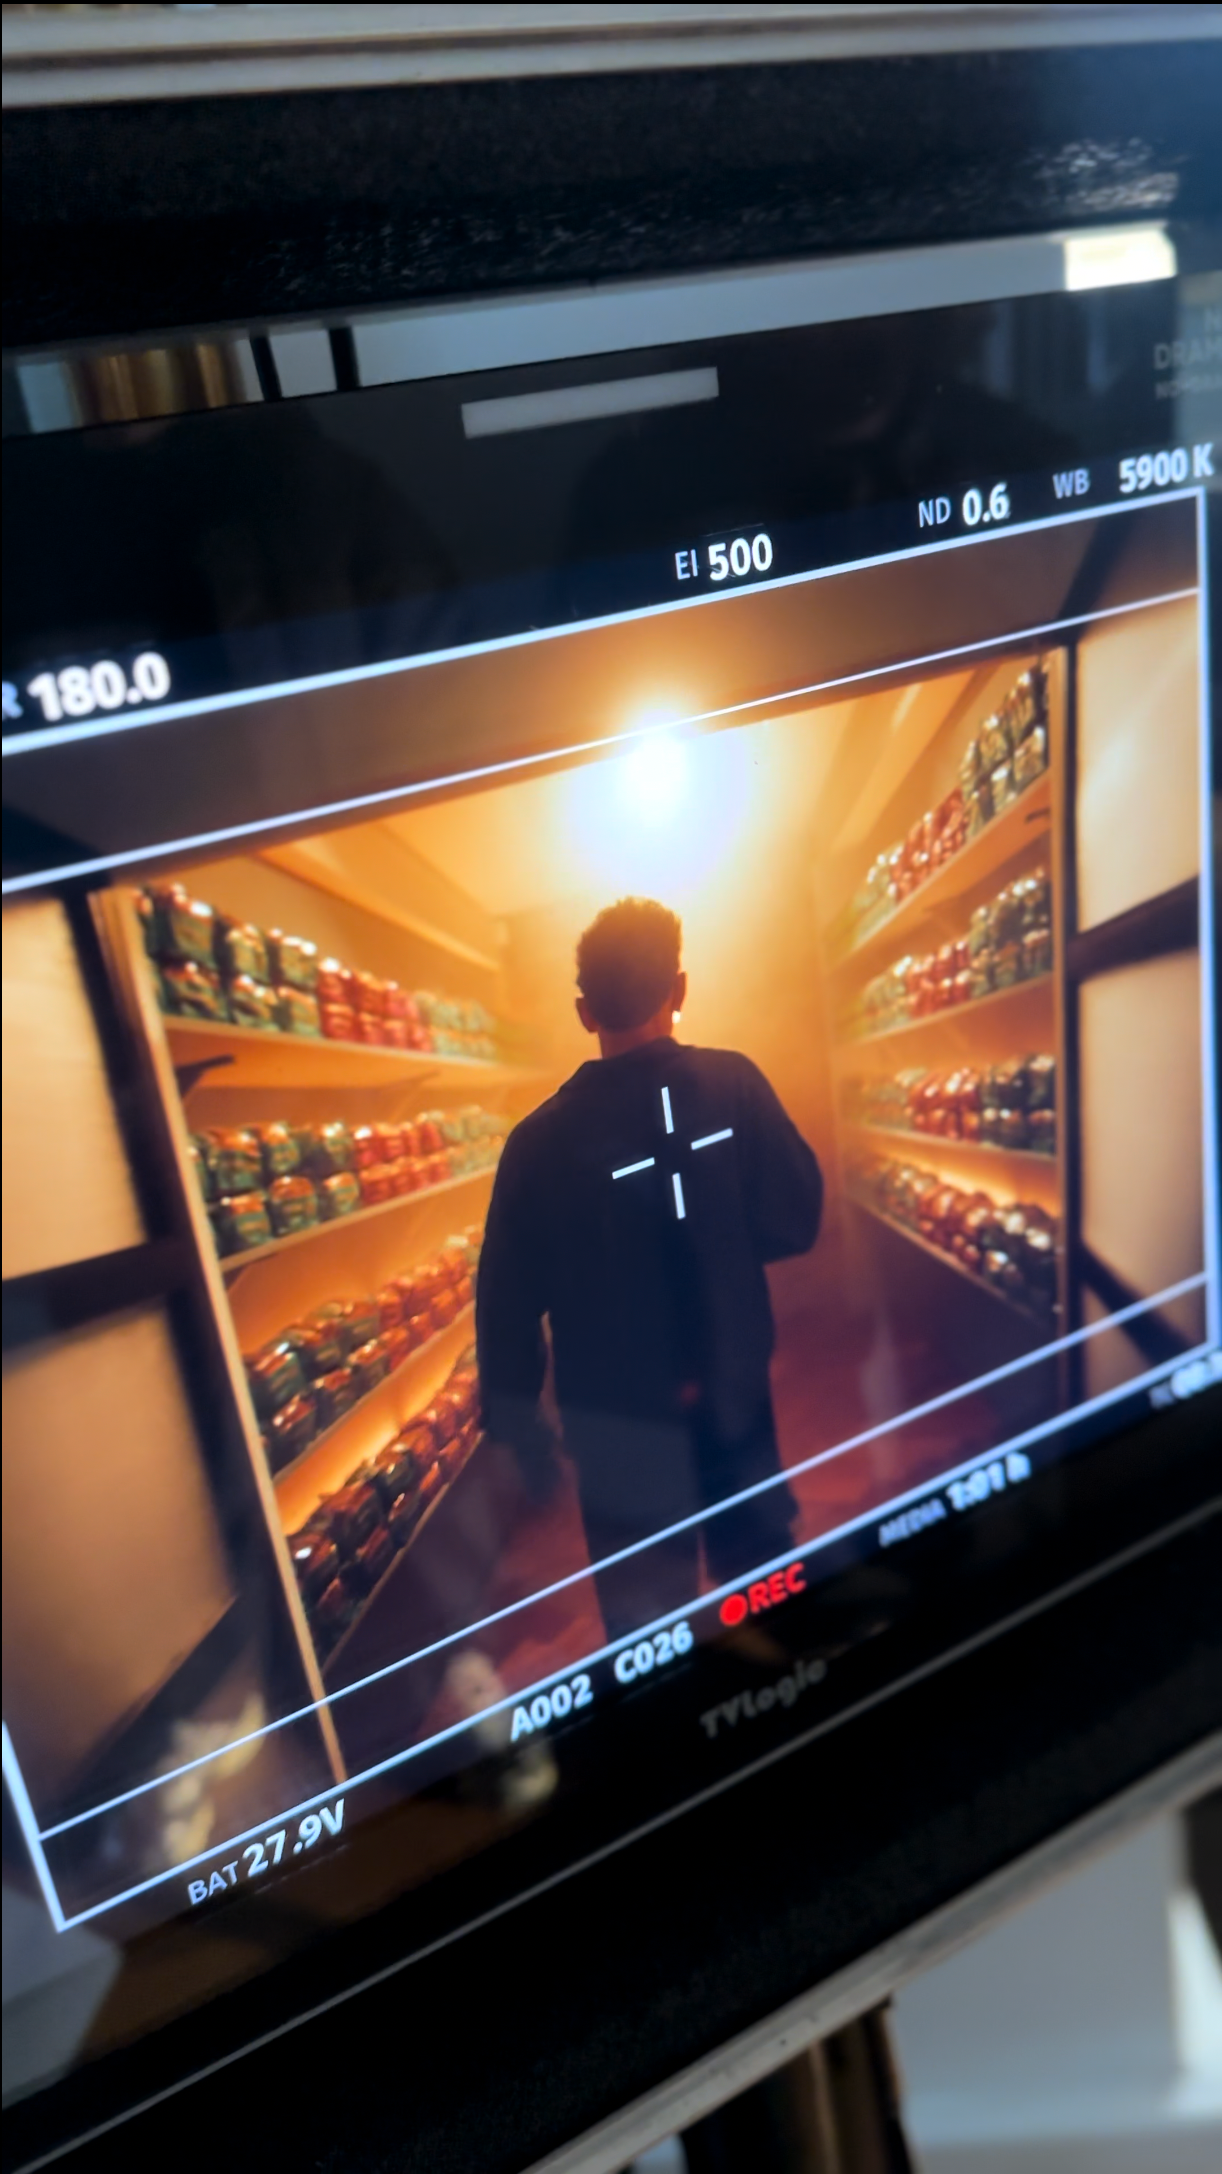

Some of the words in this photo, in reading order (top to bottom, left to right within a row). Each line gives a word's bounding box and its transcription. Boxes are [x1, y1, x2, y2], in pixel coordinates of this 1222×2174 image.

[1052, 467, 1091, 499] WB
[1119, 447, 1189, 493] 5900
[1193, 442, 1215, 478] K
[918, 496, 951, 528] ND
[962, 482, 1011, 526] 0.6
[675, 549, 698, 580] EI
[708, 533, 773, 581] 500
[27, 651, 171, 721] 180.0
[748, 1561, 807, 1614] REC
[511, 1673, 595, 1742] A002
[613, 1620, 694, 1684] C026
[187, 1860, 239, 1906] BAT
[242, 1797, 345, 1878] 27.9V
